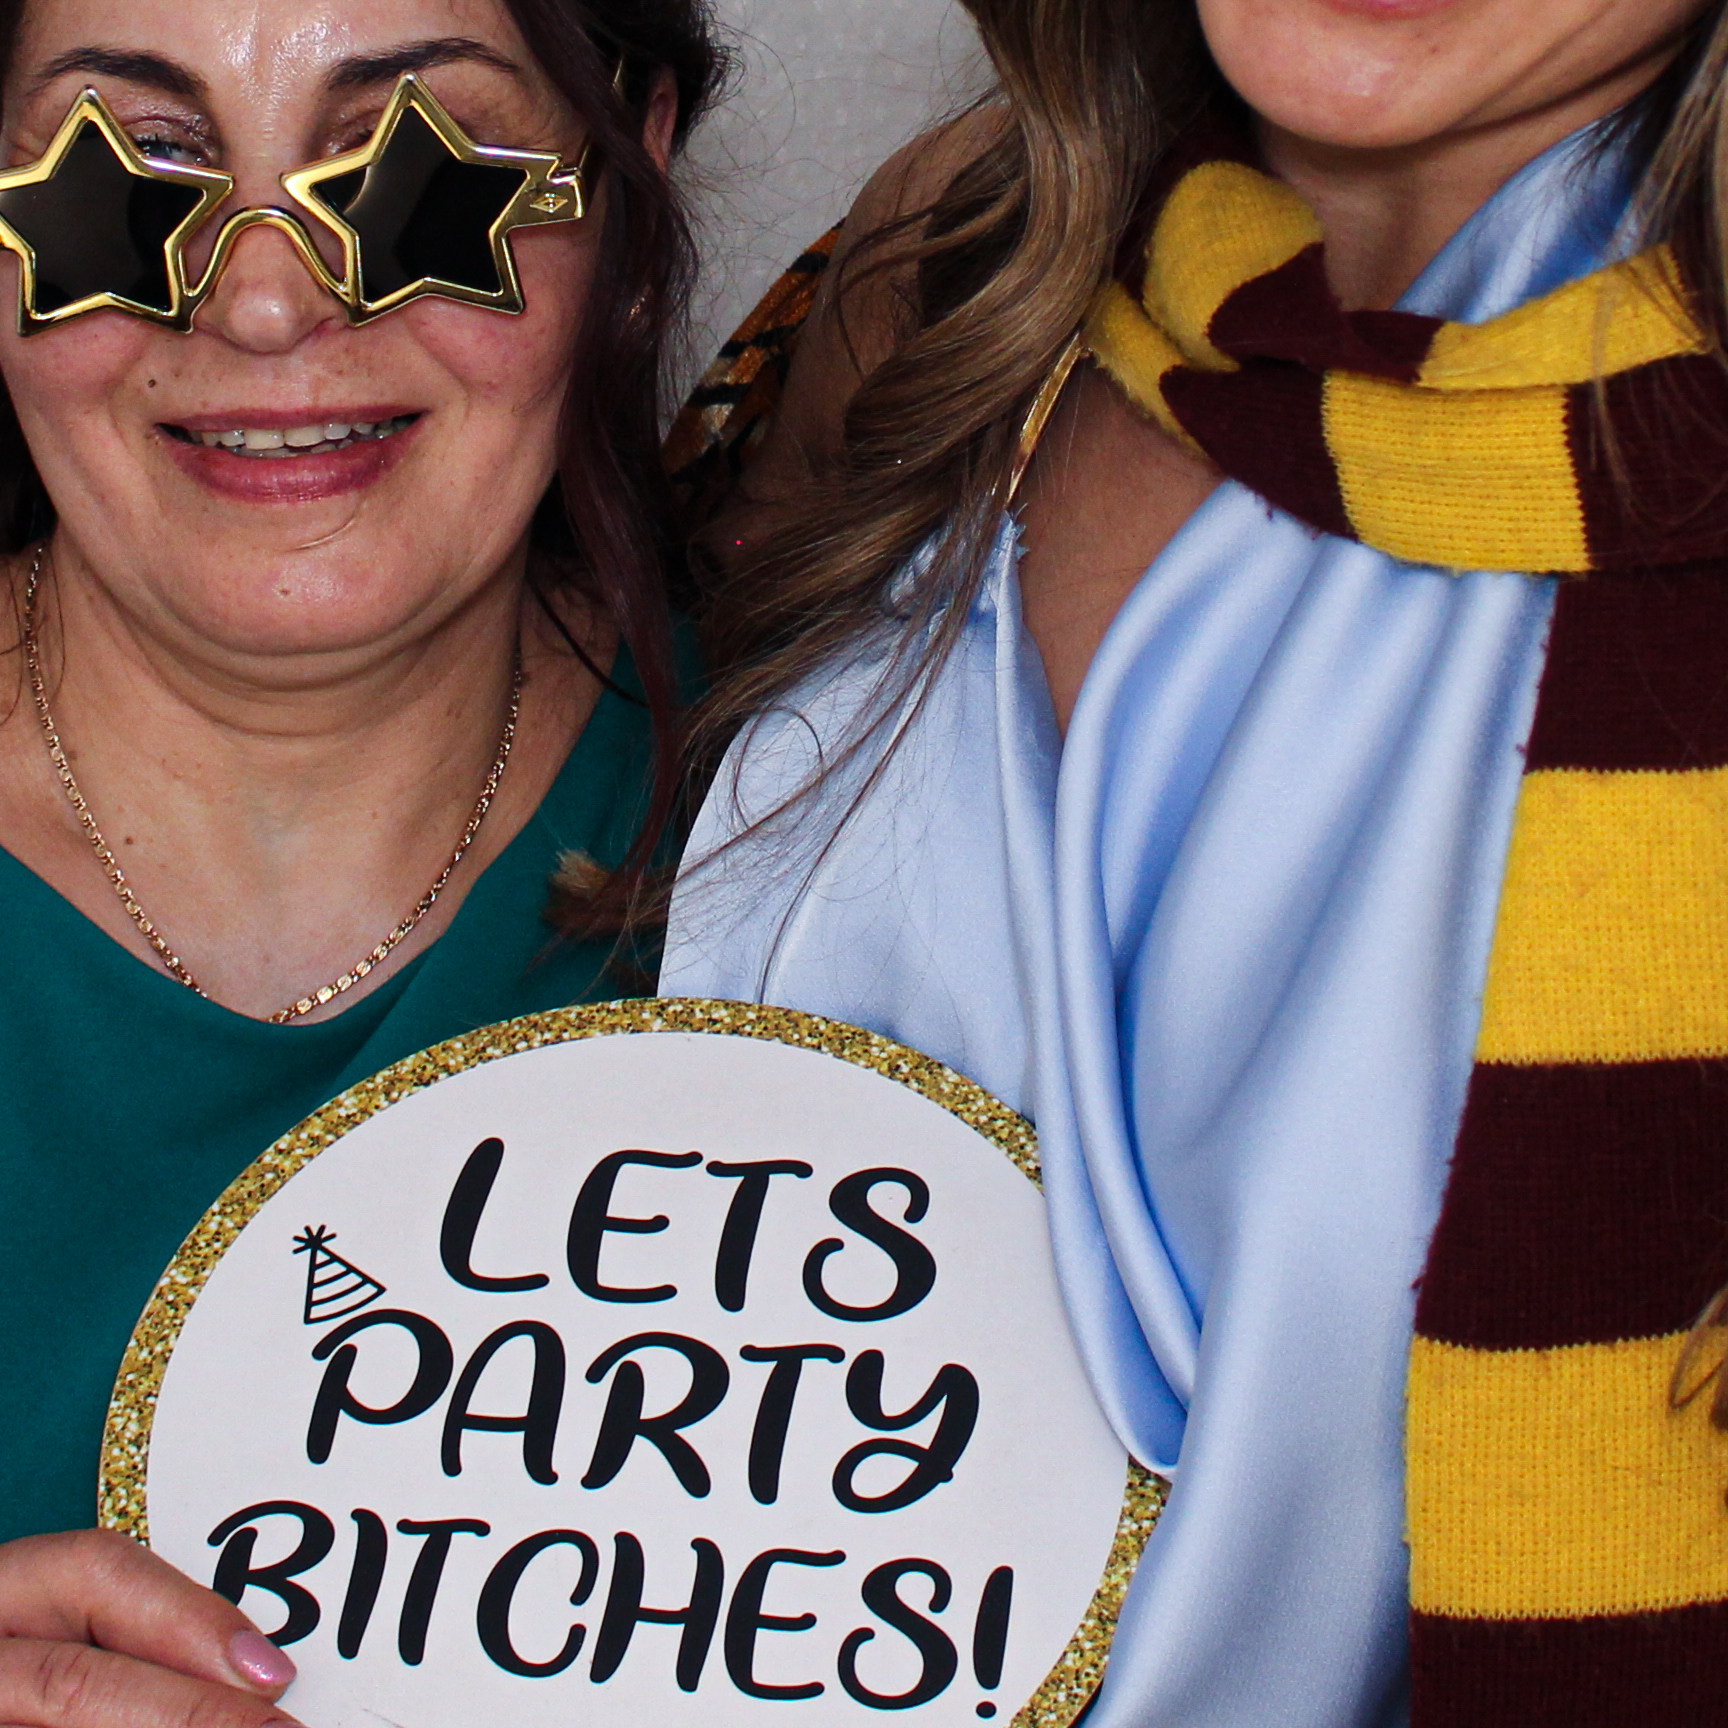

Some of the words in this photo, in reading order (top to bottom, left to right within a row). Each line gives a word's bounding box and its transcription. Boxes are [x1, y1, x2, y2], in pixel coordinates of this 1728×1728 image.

[440, 1138, 937, 1322] LETS
[307, 1310, 980, 1513] PARTY
[207, 1500, 1015, 1719] BITCHES!
